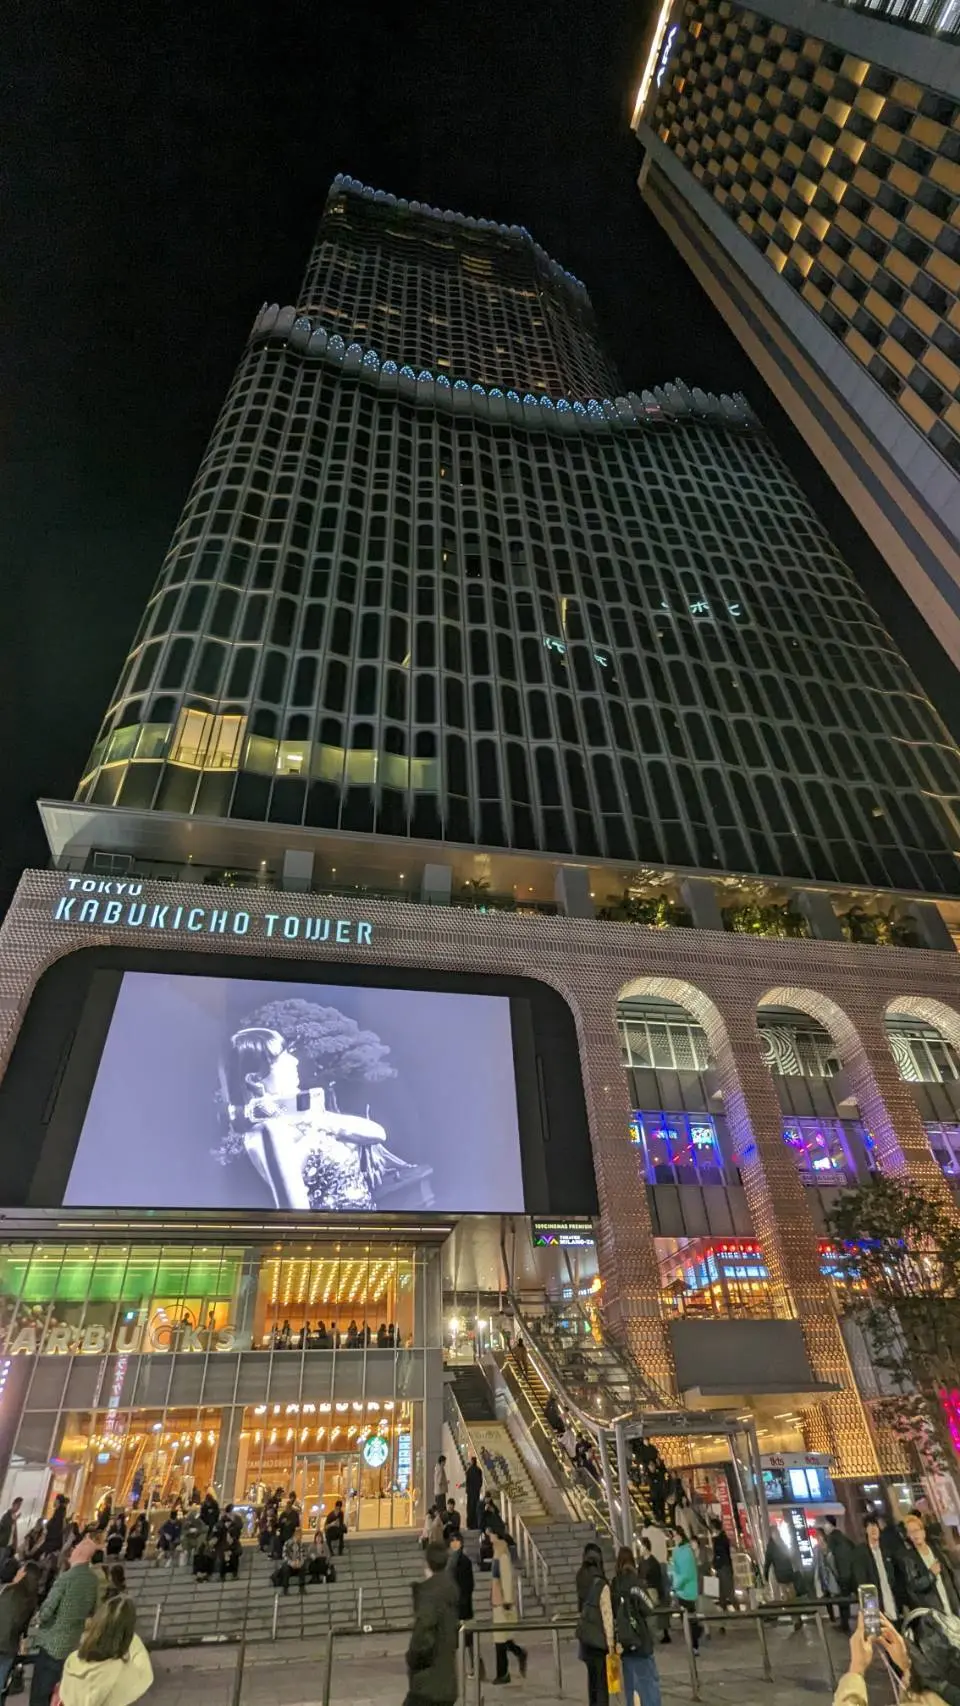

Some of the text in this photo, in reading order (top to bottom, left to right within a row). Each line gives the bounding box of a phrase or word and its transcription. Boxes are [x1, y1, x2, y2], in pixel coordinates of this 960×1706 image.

[68, 878, 142, 896] TOKYU
[55, 897, 373, 945] KABUKICHO TOWER
